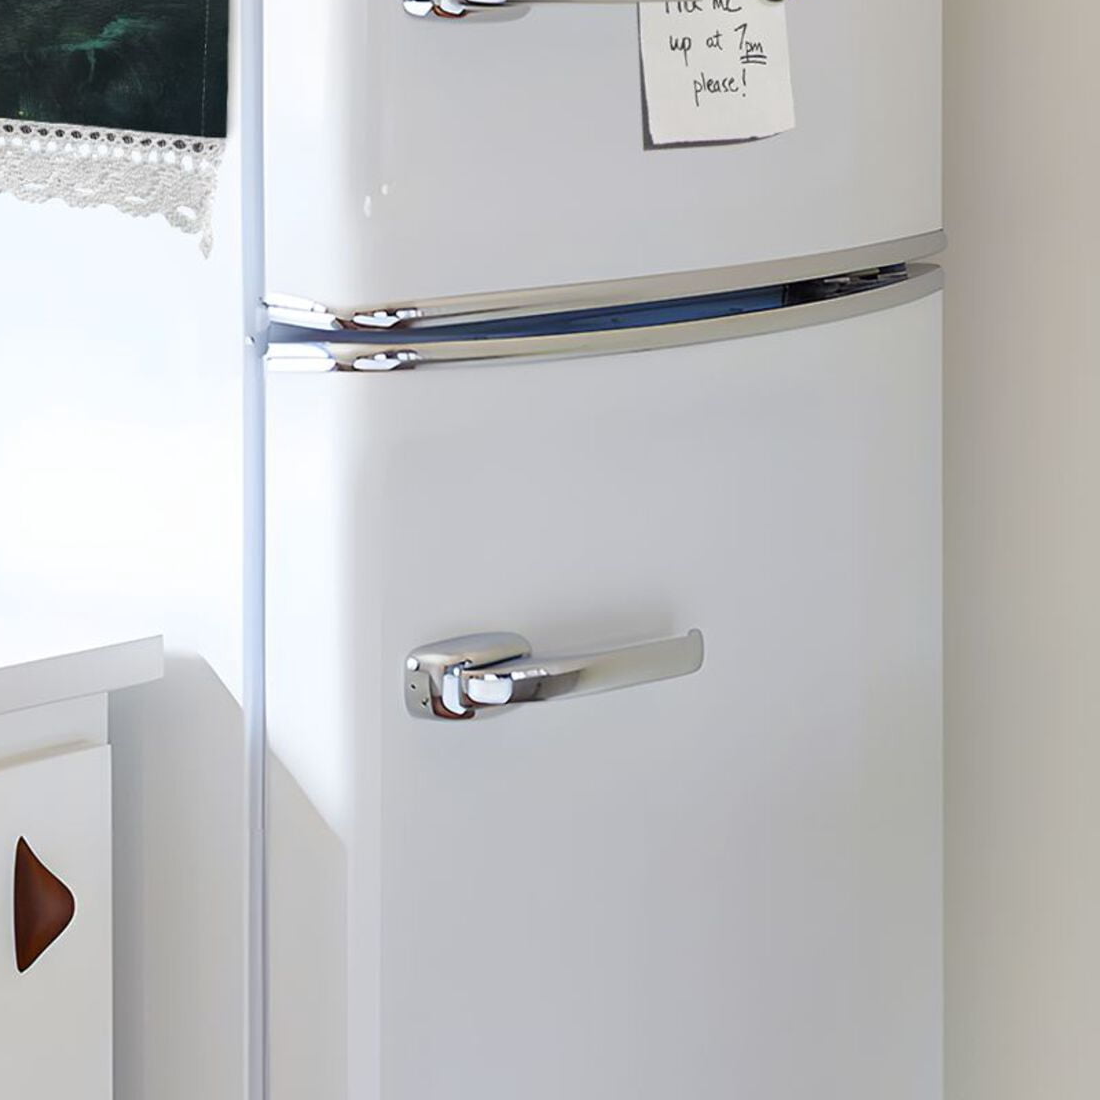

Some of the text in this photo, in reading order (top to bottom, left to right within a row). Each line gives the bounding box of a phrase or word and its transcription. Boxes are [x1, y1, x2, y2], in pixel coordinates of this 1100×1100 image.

[669, 35, 692, 66] up
[706, 30, 723, 50] at
[693, 68, 747, 107] please!
